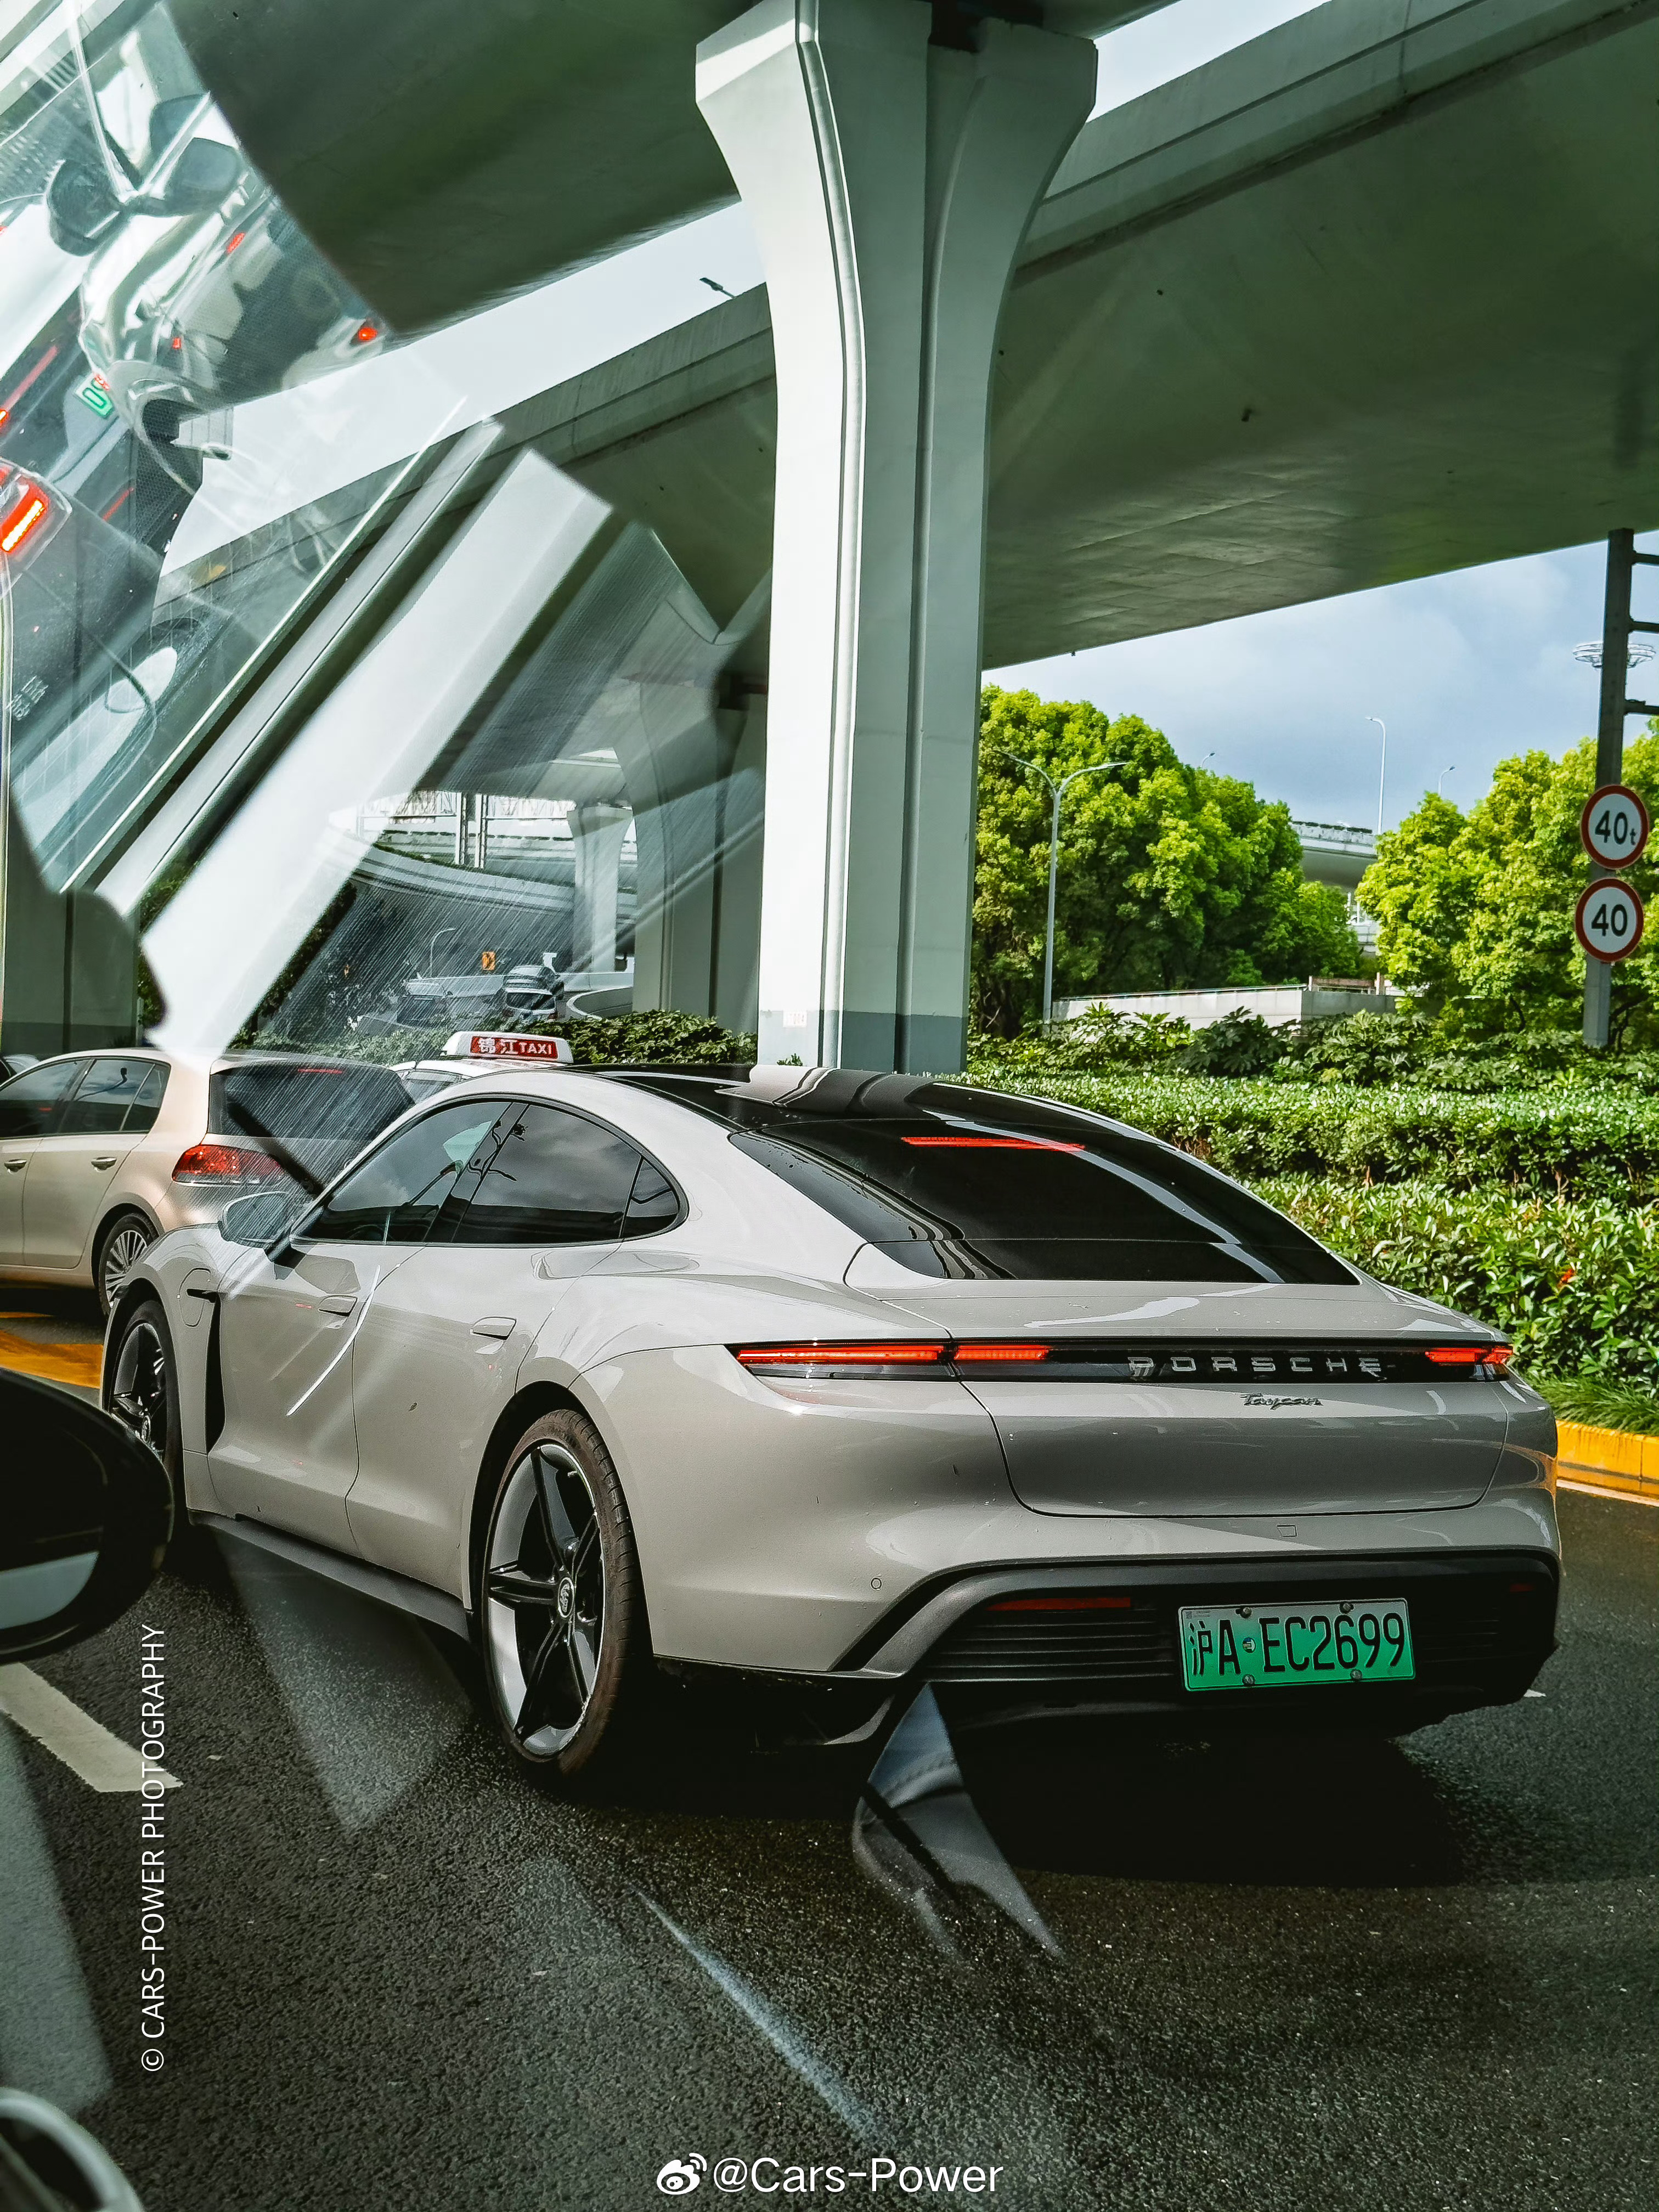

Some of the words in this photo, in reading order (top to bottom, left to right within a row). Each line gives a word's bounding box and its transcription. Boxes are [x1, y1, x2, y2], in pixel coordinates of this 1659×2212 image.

[1595, 810, 1637, 846] 40t
[1591, 904, 1628, 937] 40
[518, 1042, 552, 1055] TAXI
[1127, 1357, 1382, 1372] PORSCHE
[1239, 1392, 1324, 1410] Taycan
[1258, 1612, 1405, 1673] EC2699
